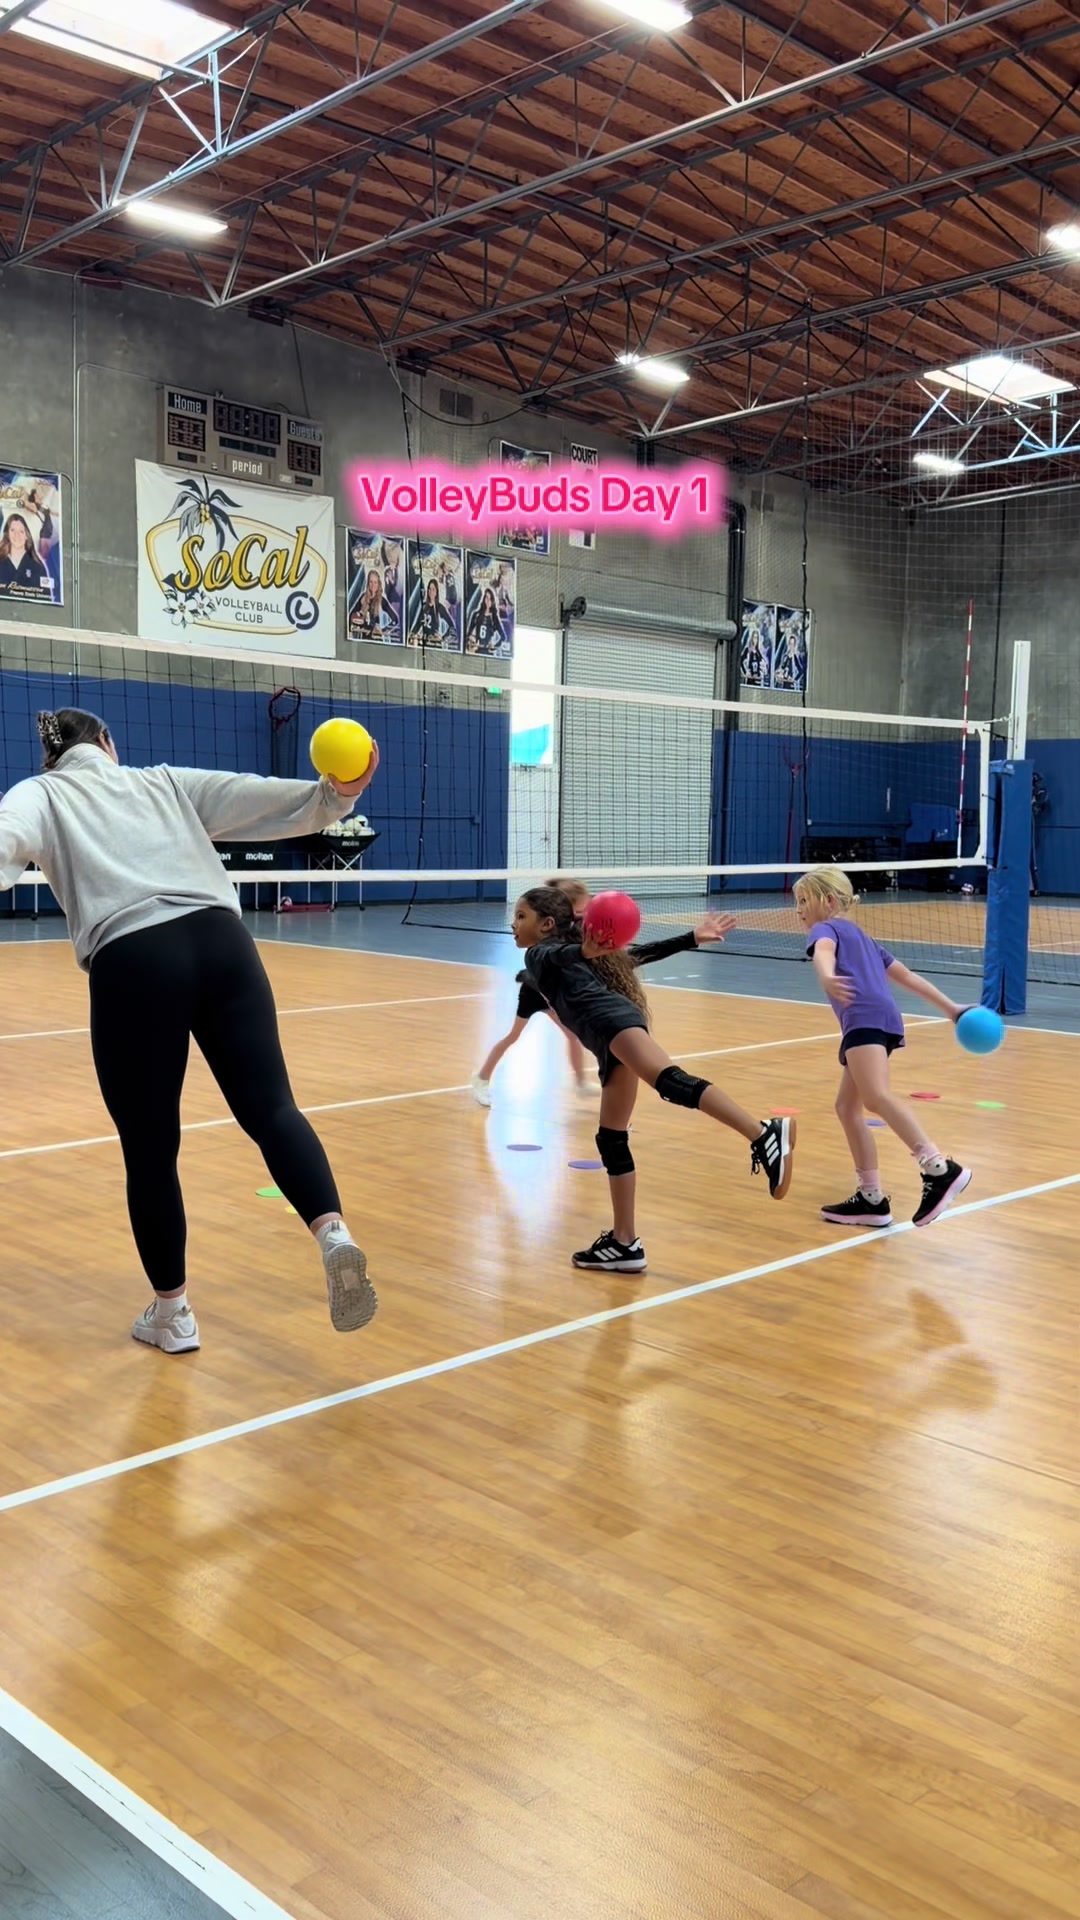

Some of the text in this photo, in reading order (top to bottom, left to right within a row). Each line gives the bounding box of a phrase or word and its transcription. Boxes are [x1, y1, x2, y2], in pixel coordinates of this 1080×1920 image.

[174, 394, 202, 414] Home
[290, 421, 322, 441] Guests
[571, 445, 597, 465] COURT
[232, 459, 263, 475] period
[174, 525, 311, 593] SoCal
[215, 596, 283, 614] VOLLEYBALL
[235, 612, 263, 623] CLUB
[480, 625, 487, 639] 6
[245, 852, 273, 861] molten
